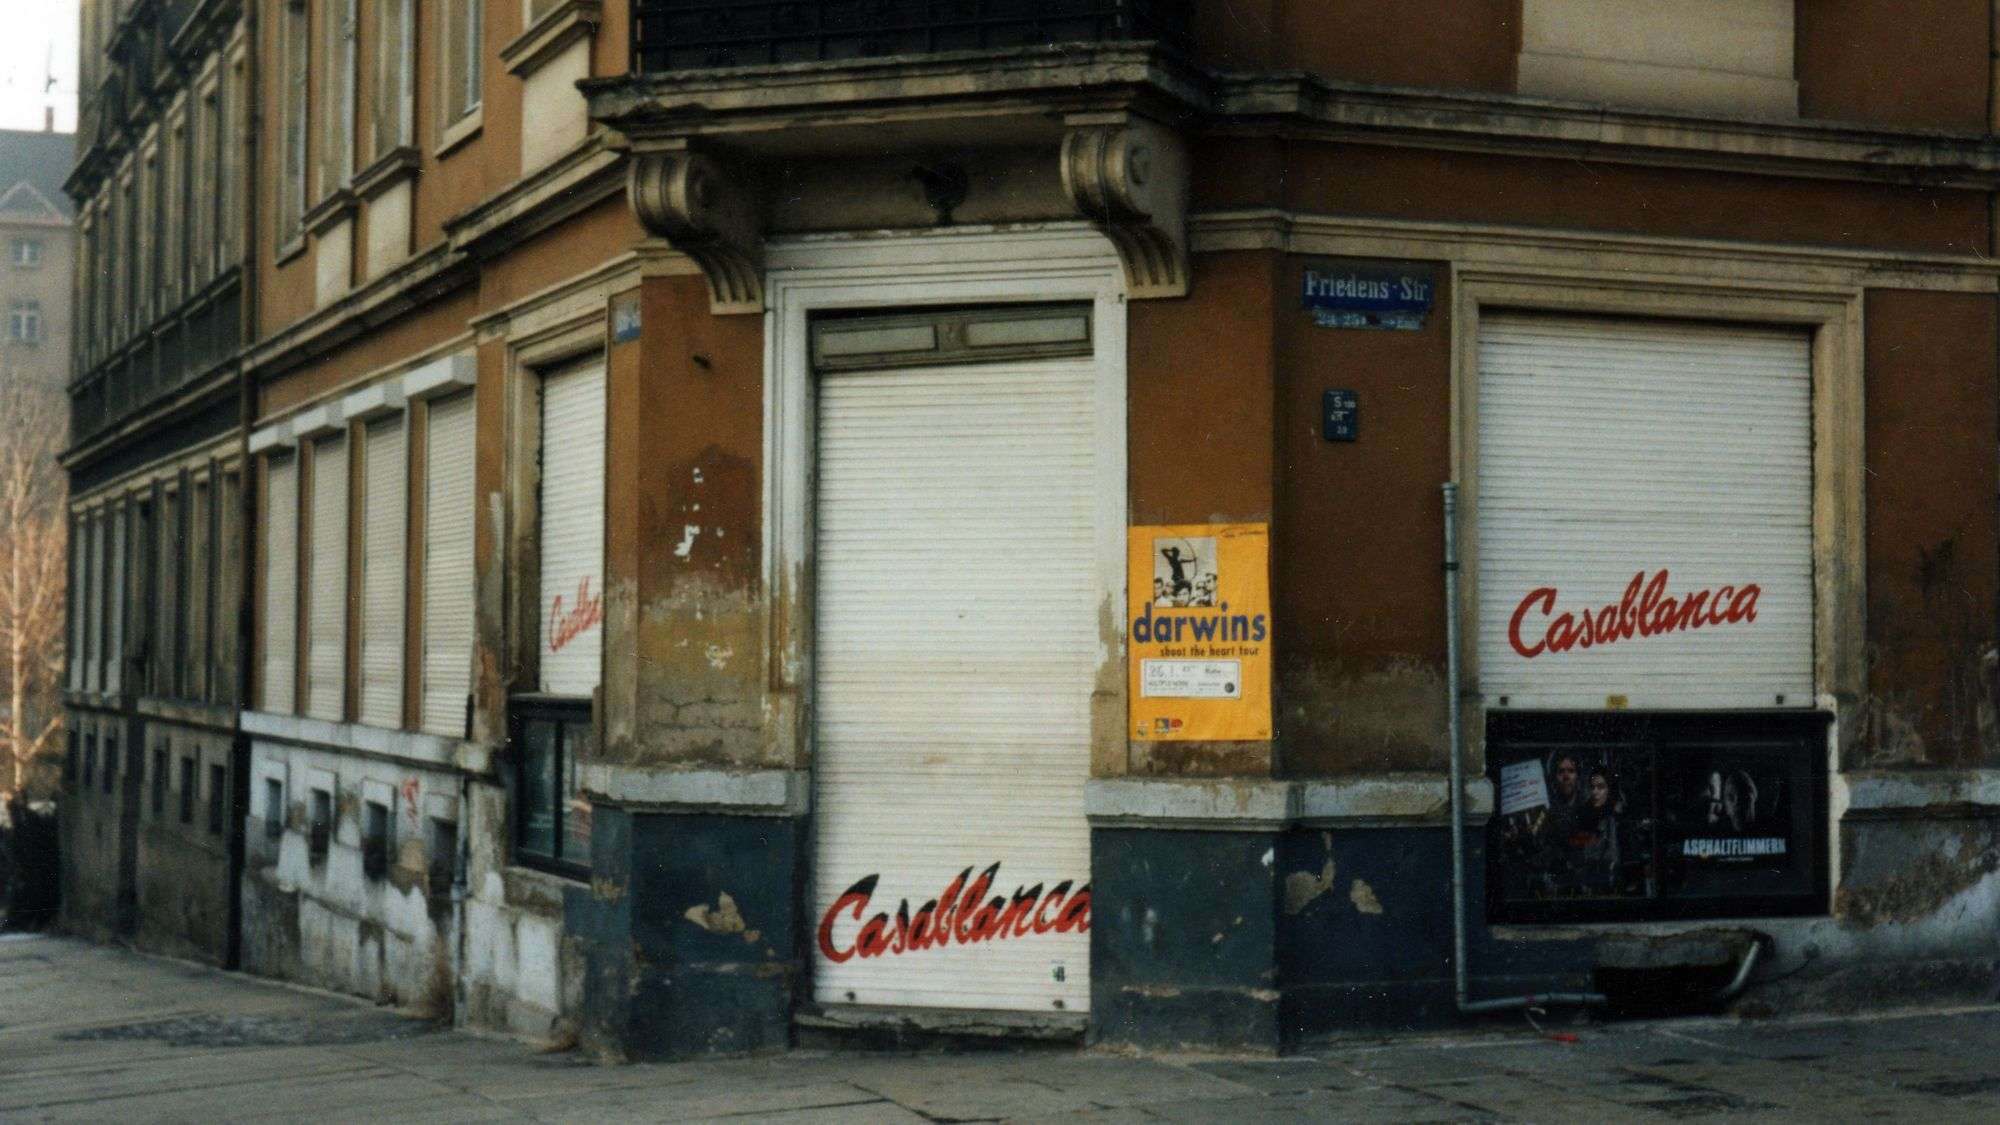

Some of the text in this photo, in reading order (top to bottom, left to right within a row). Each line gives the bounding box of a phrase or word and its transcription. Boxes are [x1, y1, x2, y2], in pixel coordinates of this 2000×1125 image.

[1133, 602, 1267, 643] darwins
[1508, 569, 1761, 658] Casablanca
[1160, 644, 1260, 657] shoot the heart tour
[1682, 838, 1787, 856] ASPHALTFLIMMERN
[818, 861, 1090, 963] Casablanca
